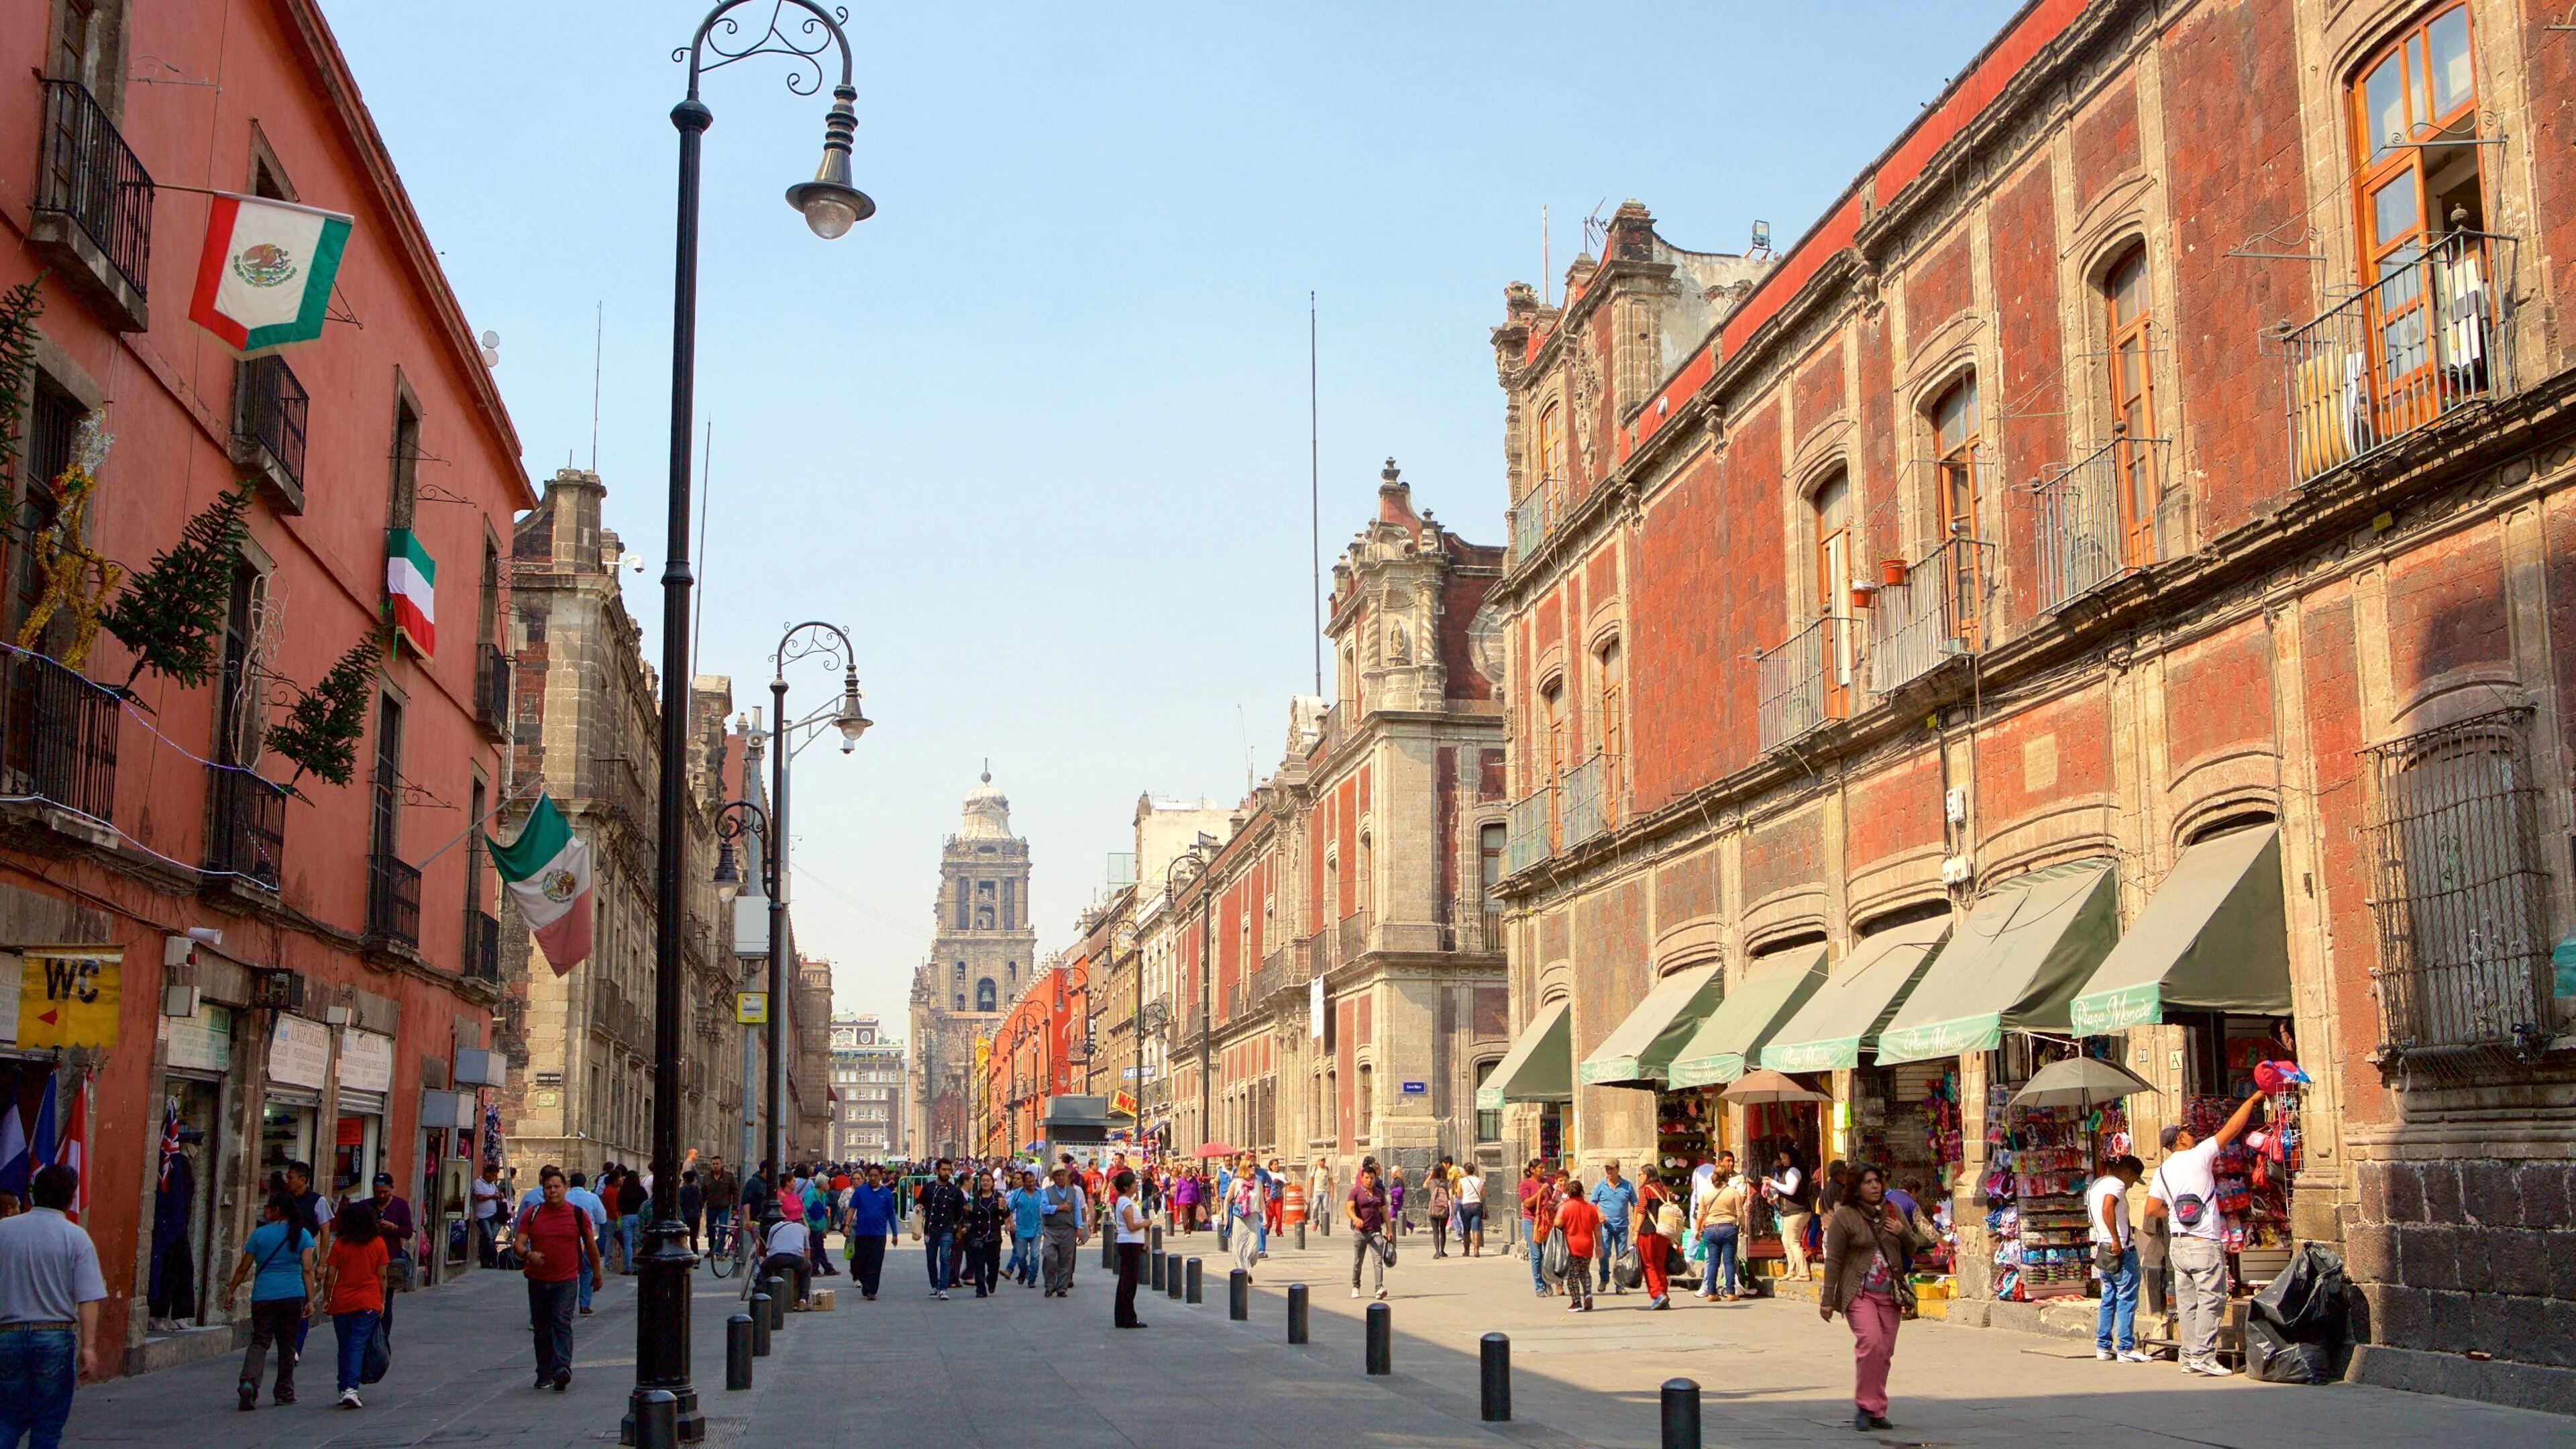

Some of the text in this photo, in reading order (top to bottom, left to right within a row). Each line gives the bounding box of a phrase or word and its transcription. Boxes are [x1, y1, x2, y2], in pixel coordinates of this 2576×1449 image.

[45, 958, 99, 1004] WC
[2071, 991, 2151, 1037] Plaza Moneda
[1904, 1025, 1964, 1059] Plaza Moneda
[2171, 1054, 2180, 1068] A
